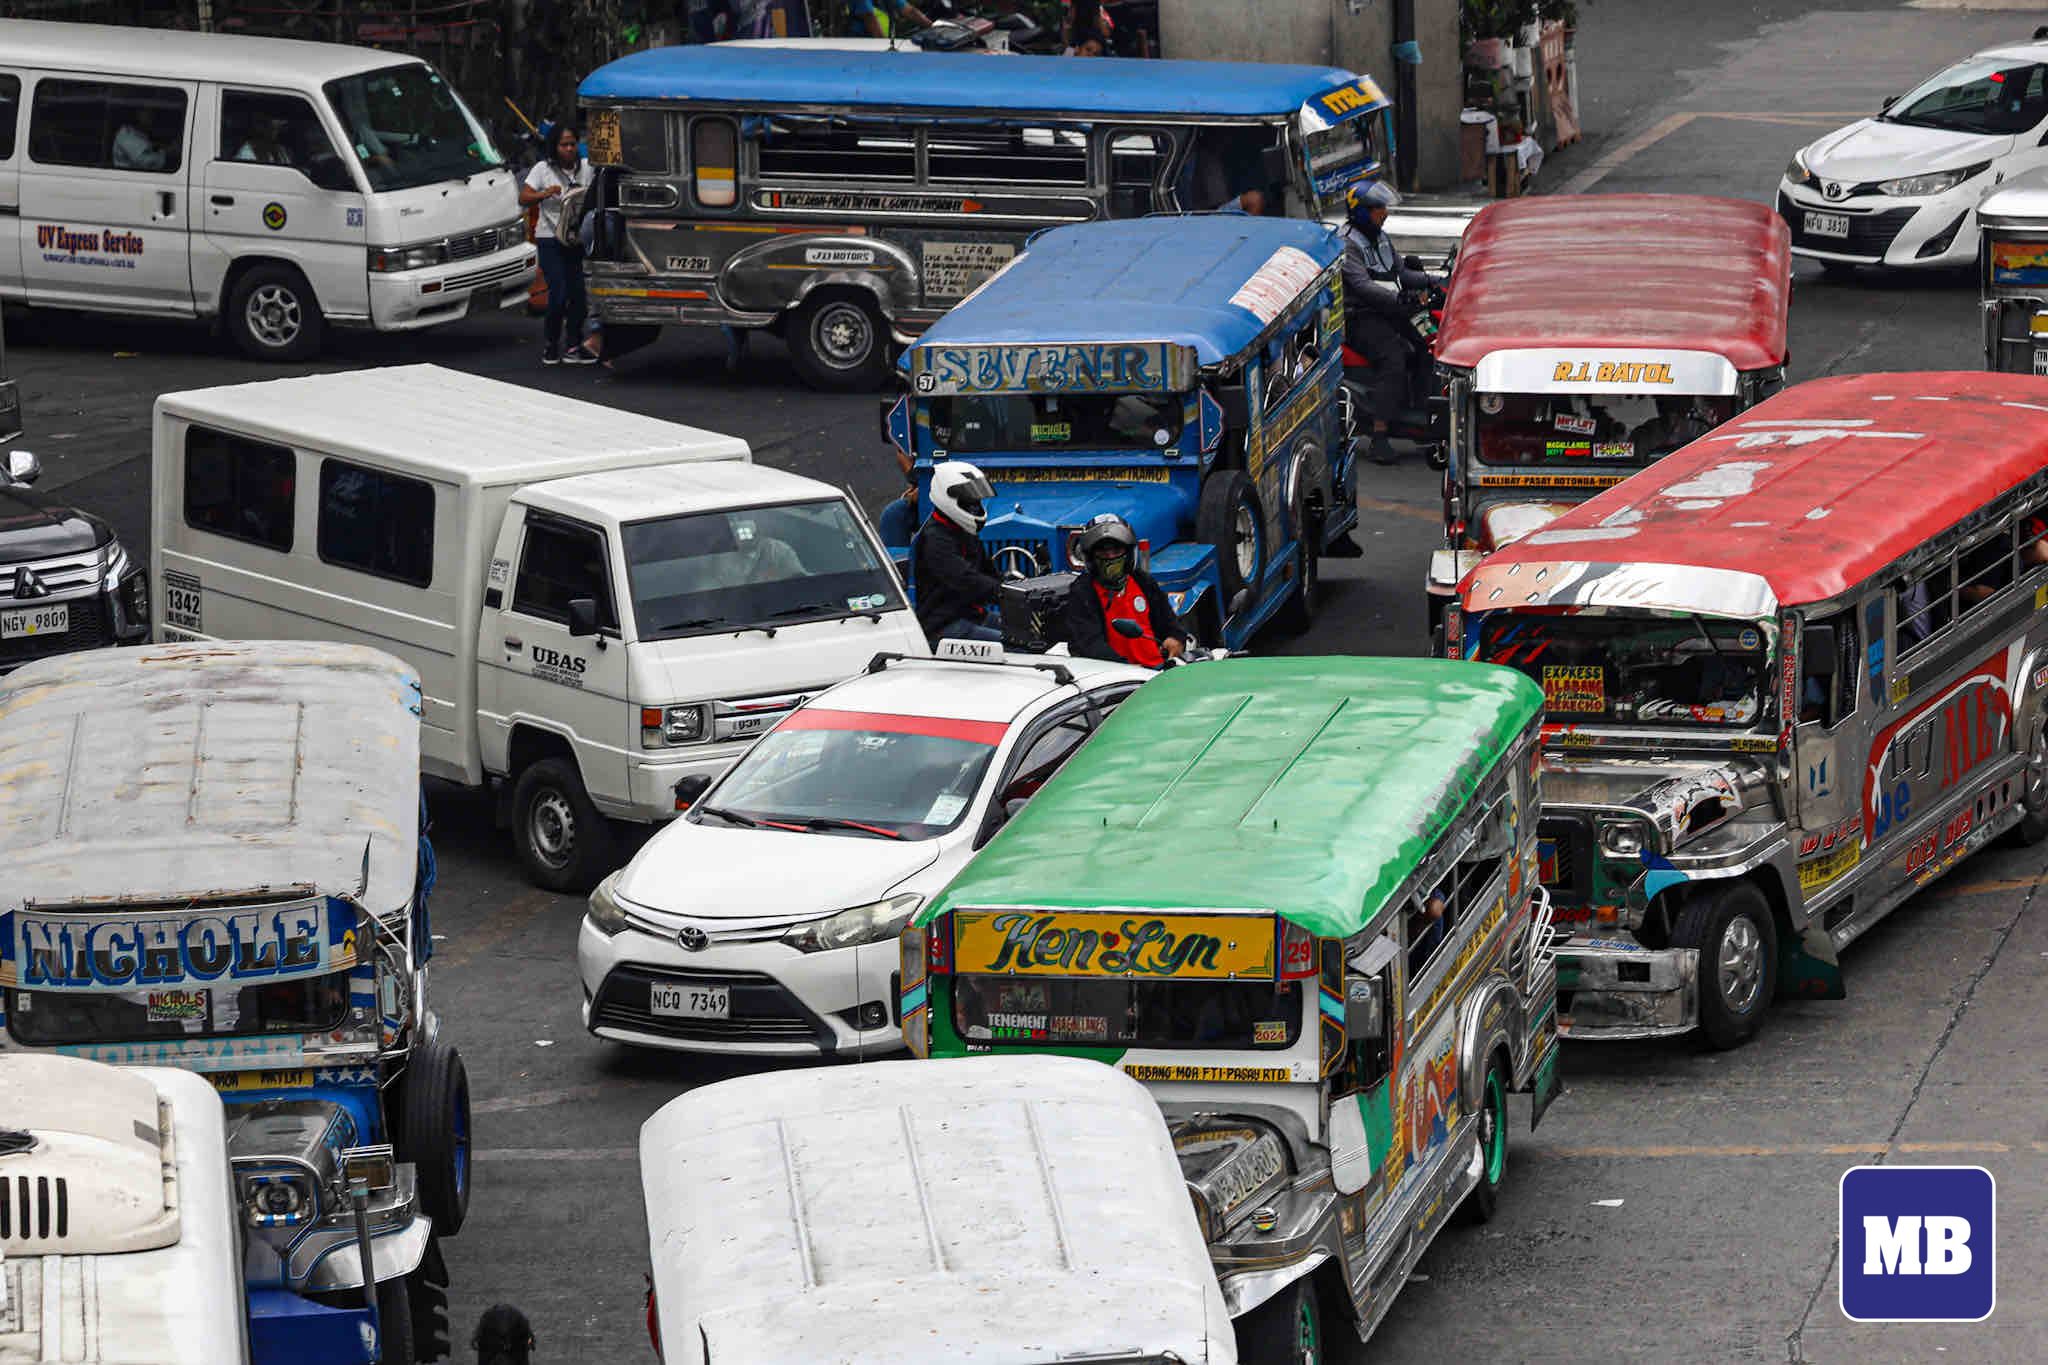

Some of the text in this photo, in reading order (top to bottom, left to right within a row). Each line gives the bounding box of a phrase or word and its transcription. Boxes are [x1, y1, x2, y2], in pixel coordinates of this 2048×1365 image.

[37, 224, 144, 256] UV Express Service
[919, 376, 935, 391] 57
[1595, 363, 1675, 384] BATOL
[167, 588, 200, 615] 1342
[3, 611, 67, 634] NGY 9809
[532, 645, 587, 673] UBAS
[944, 643, 992, 657] TAXI
[1544, 666, 1601, 679] EXPRESS
[23, 904, 321, 987] NICHOLE
[985, 913, 1223, 975] Hen Lyn
[1287, 941, 1311, 964] 29
[691, 992, 726, 1013] 7349
[987, 1013, 1048, 1029] TENEMENT
